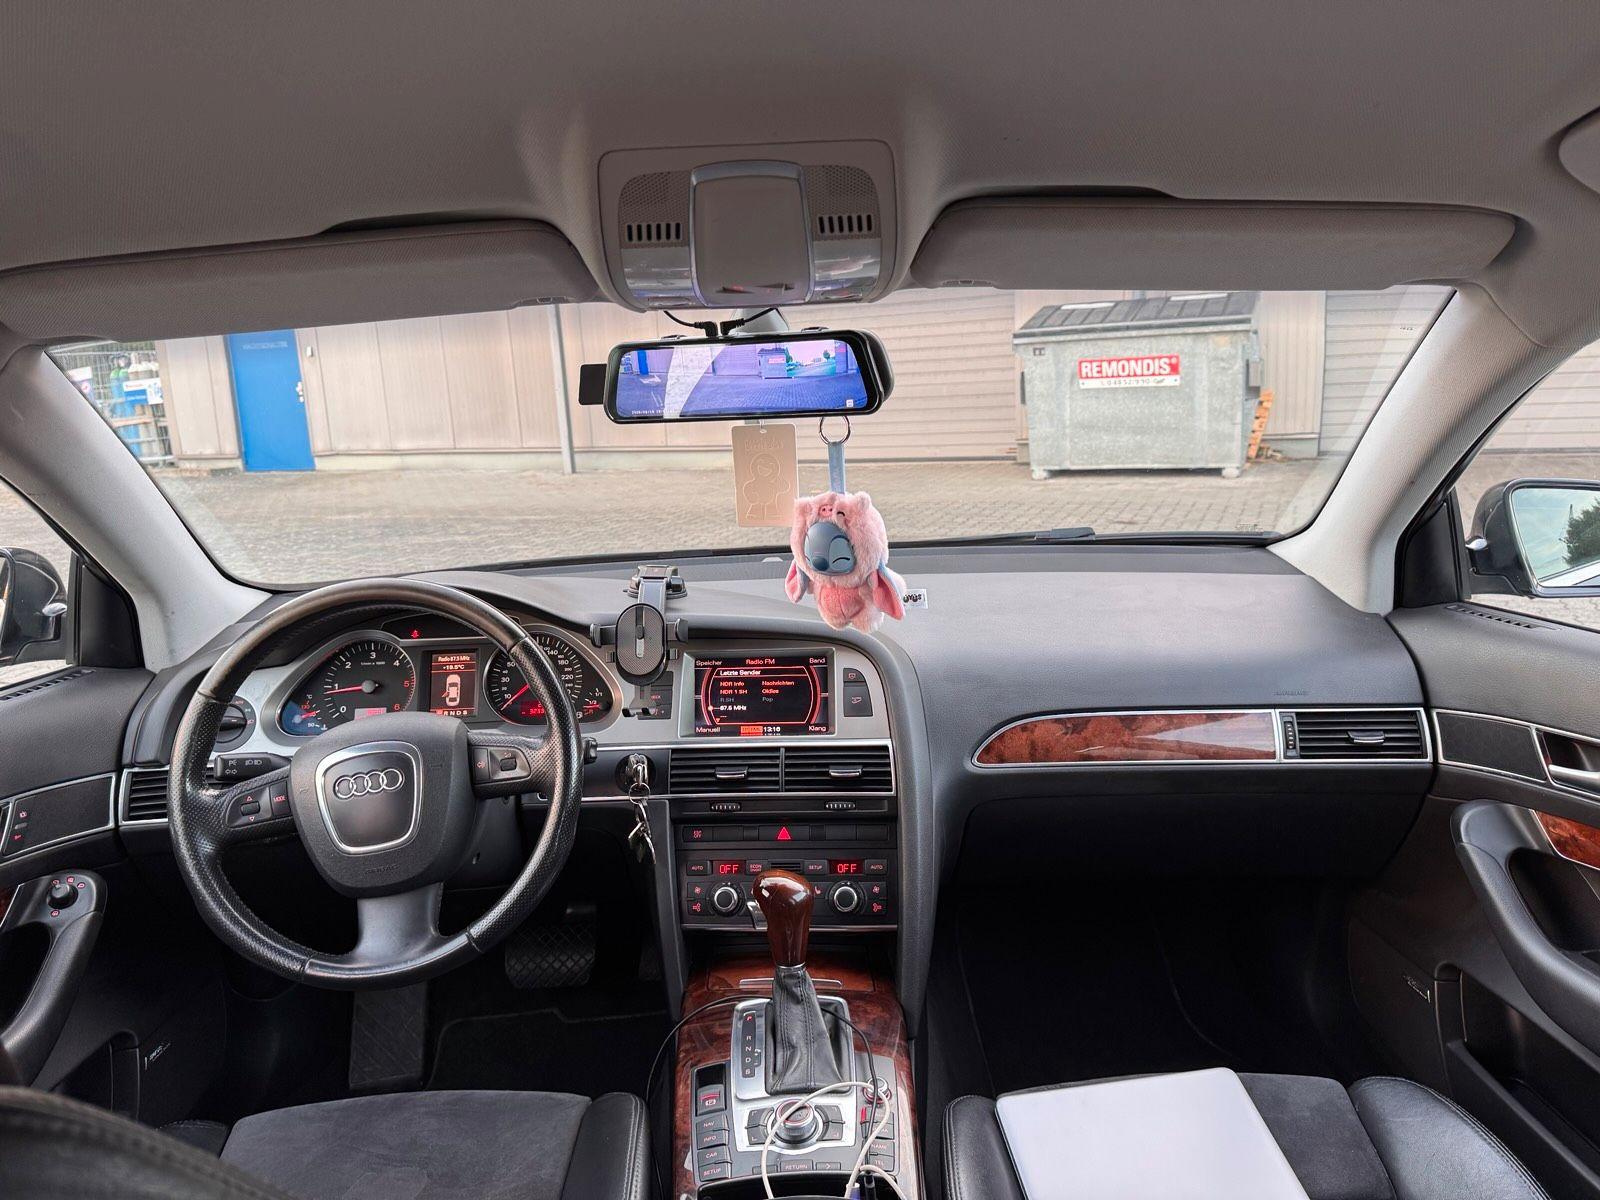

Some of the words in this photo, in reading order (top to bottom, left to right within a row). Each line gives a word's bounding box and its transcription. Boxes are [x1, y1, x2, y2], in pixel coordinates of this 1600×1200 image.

[1081, 358, 1171, 379] REMONDIS
[370, 651, 376, 660] 3
[345, 661, 352, 669] 2
[393, 659, 400, 667] 4
[403, 680, 410, 688] 5
[340, 705, 347, 713] 0
[393, 703, 401, 711] 6
[719, 864, 740, 874] OFF
[837, 863, 857, 873] OFF
[705, 1151, 718, 1159] CAR
[703, 1167, 721, 1177] SETUP
